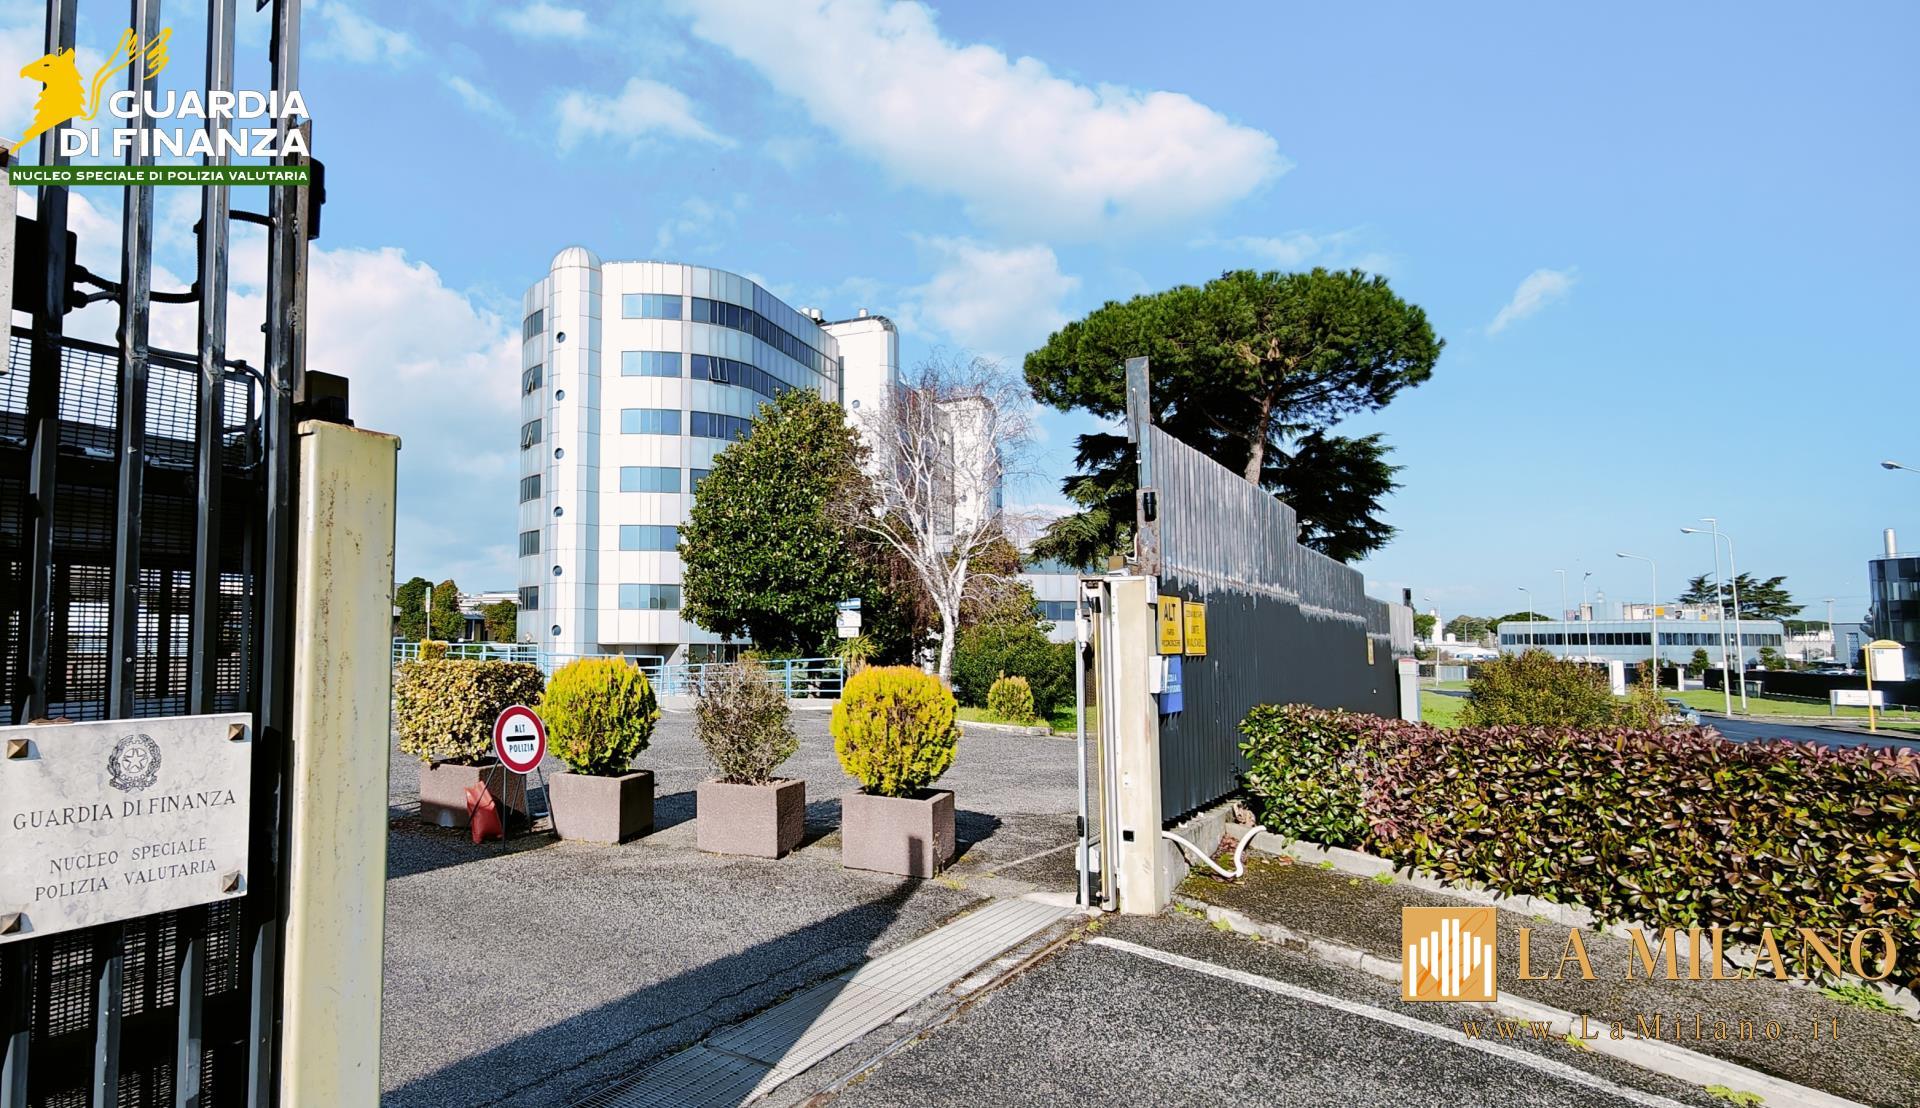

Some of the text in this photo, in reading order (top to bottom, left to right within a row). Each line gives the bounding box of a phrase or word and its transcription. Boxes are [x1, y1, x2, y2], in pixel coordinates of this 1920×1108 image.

[1164, 603, 1176, 621] ALT
[514, 724, 525, 733] ALT
[509, 743, 534, 752] POLIZIA
[13, 789, 236, 830] GUARDIA DI FINANZA
[50, 837, 207, 874] NUCLEO SPECIALE
[35, 859, 217, 901] POLIZIA VALUTARIA
